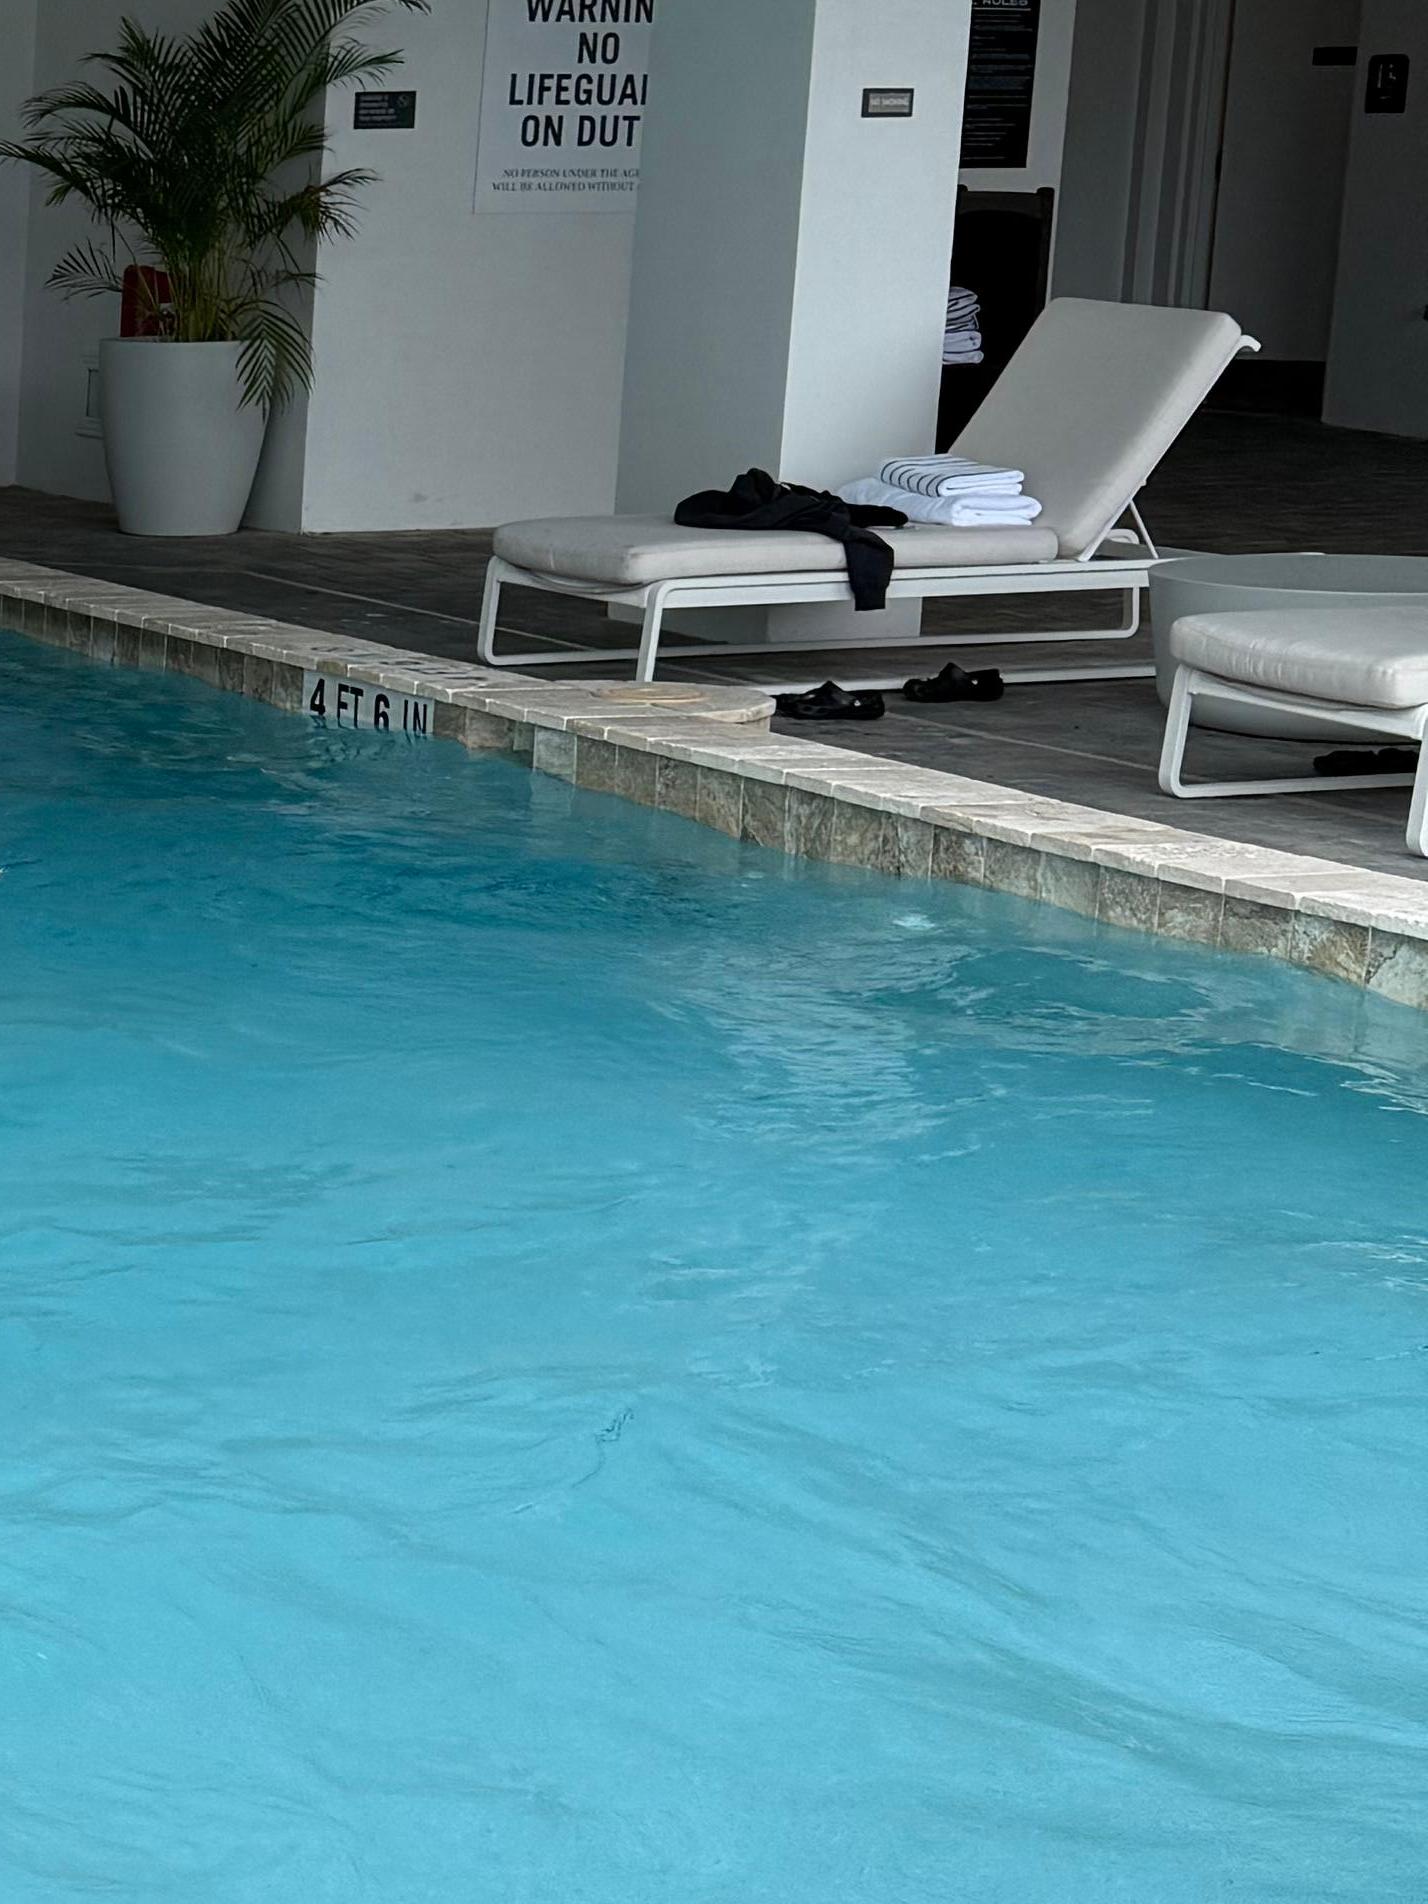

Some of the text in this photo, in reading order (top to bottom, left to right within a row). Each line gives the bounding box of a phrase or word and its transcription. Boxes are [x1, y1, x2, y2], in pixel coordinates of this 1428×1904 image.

[577, 32, 620, 64] NO
[509, 73, 648, 105] LIFEGUA
[521, 115, 641, 146] ON DUT
[492, 182, 518, 192] WILL
[536, 182, 586, 192] ALLOWED
[588, 182, 635, 192] WITHOUT
[520, 168, 560, 178] PERSON
[562, 168, 597, 178] UNDER
[600, 168, 619, 178] THE
[310, 678, 428, 735] 4 FT 6 IN
